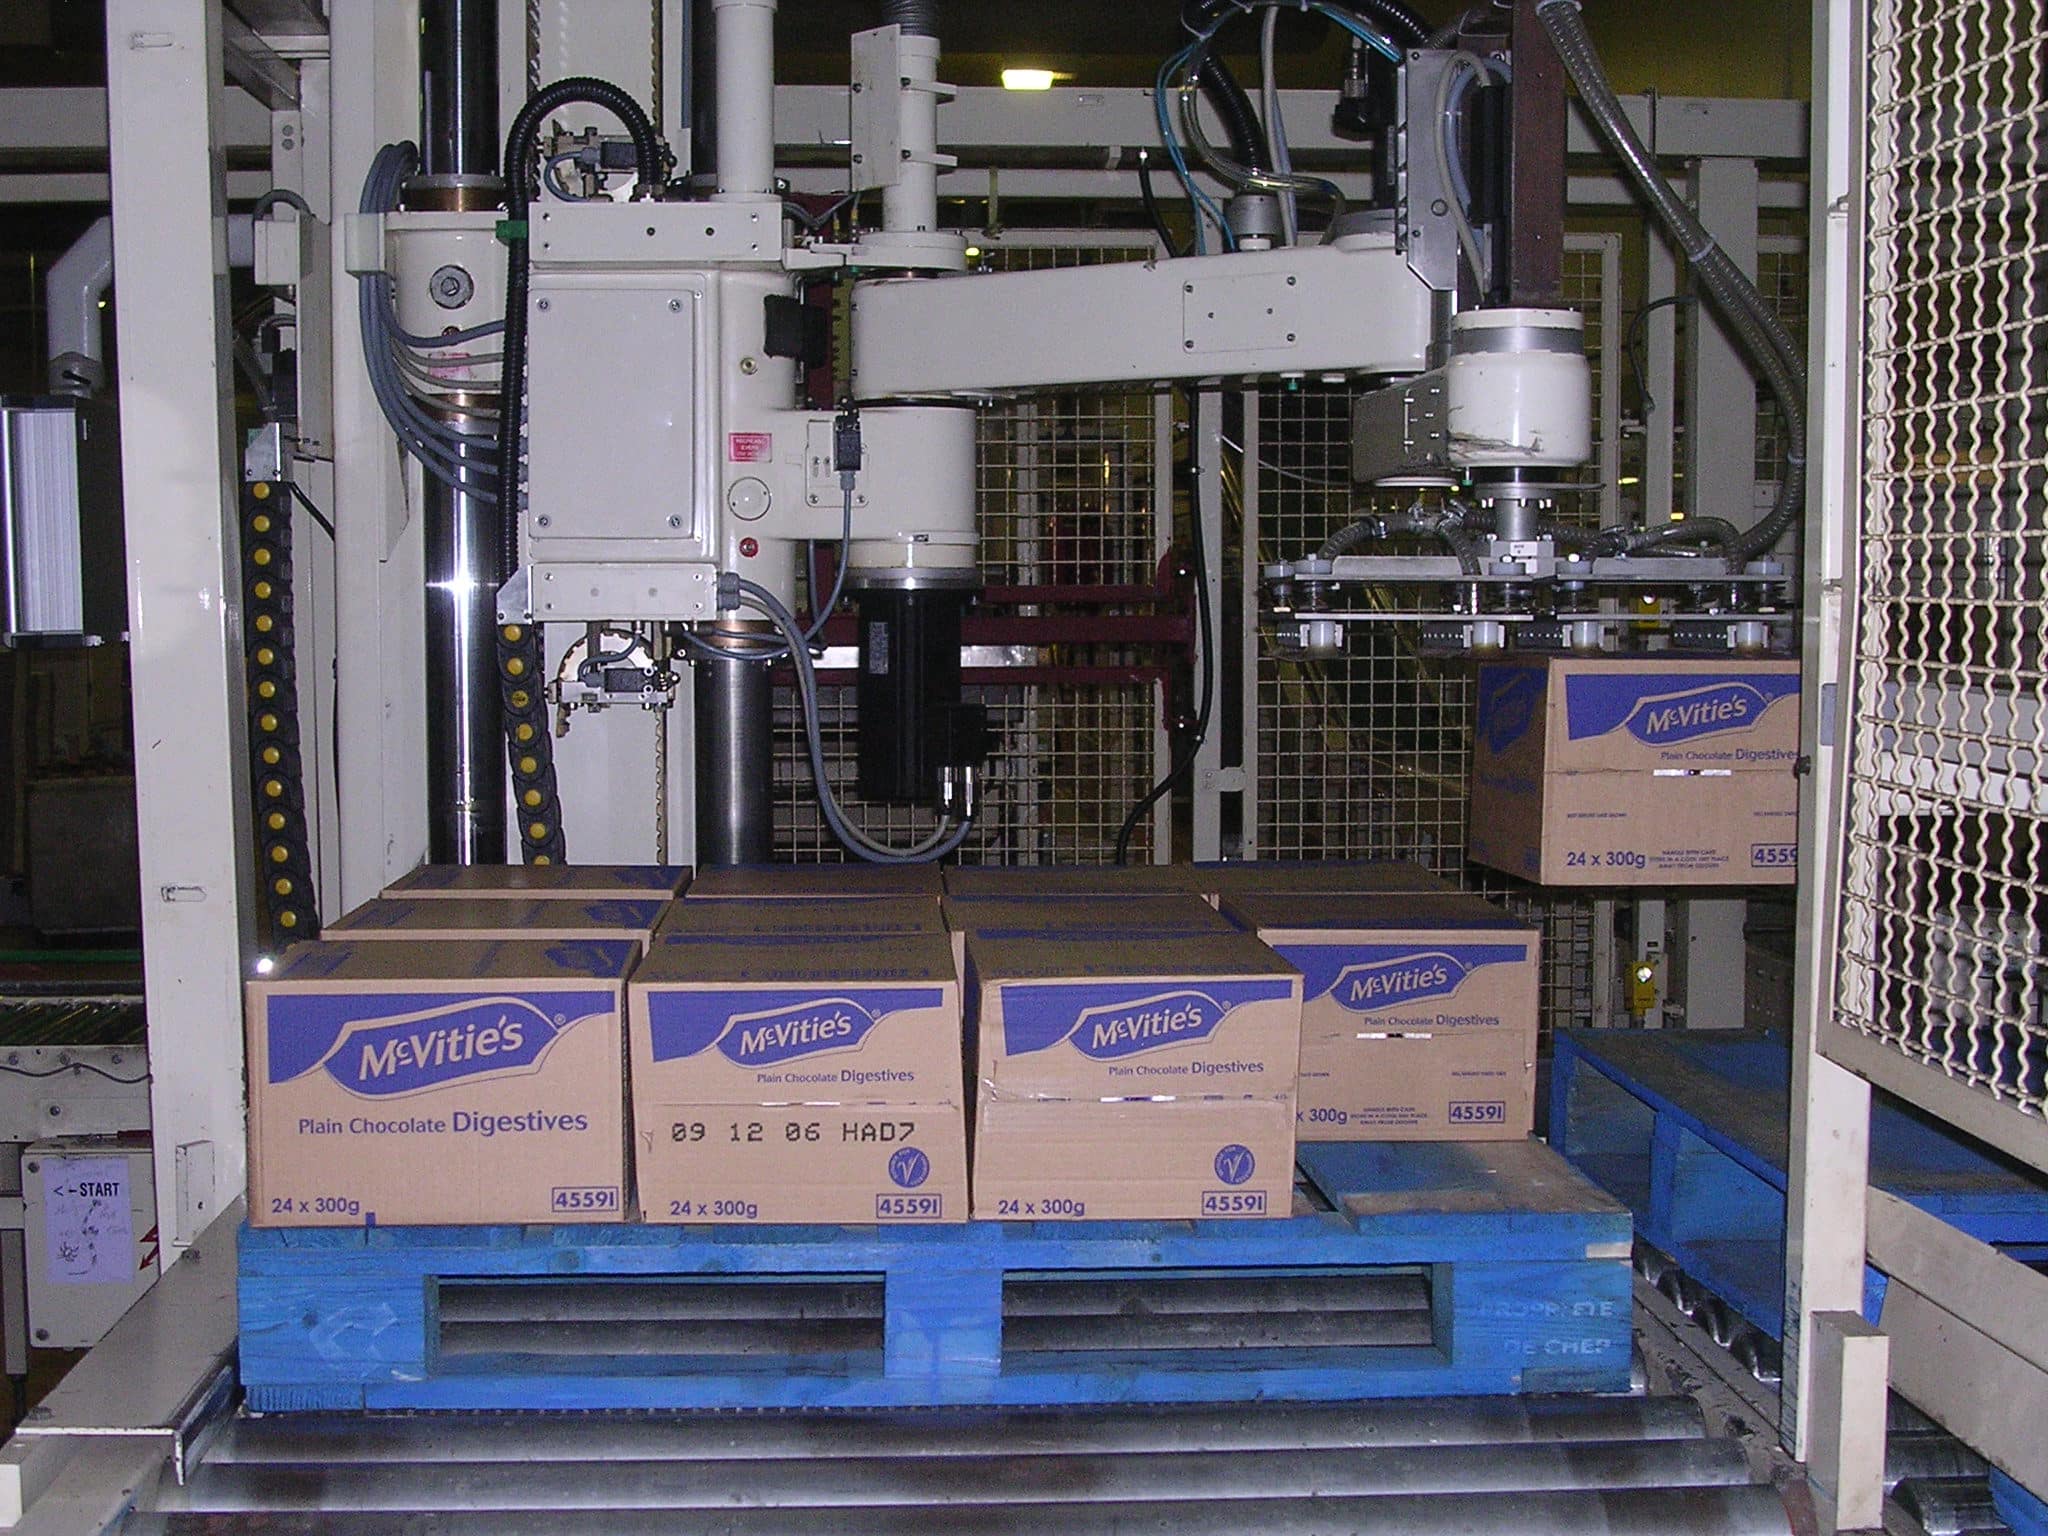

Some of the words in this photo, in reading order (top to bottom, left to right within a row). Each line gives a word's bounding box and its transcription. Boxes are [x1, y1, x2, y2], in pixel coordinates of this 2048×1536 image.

[1646, 696, 1748, 735] McVitie's
[1661, 751, 1683, 760] Plain
[1686, 750, 1733, 760] Chocolate
[1735, 747, 1799, 763] Digestive
[1567, 852, 1585, 866] 24
[1591, 856, 1600, 866] x
[1606, 852, 1646, 868] 300g
[1754, 848, 1798, 863] 4559
[1351, 964, 1447, 1002] McVitie's
[1092, 1003, 1202, 1049] McVitie's
[1364, 1016, 1386, 1026] Plain
[1388, 1016, 1433, 1026] Chocolate
[1436, 1014, 1500, 1028] Digestives
[740, 1011, 852, 1056] McVitie's
[358, 1014, 524, 1081] McVitie's
[757, 1073, 782, 1083] Plain
[785, 1072, 838, 1083] Chocolate
[840, 1068, 915, 1085] Digestives
[1108, 1066, 1133, 1076] Plain
[1136, 1065, 1189, 1076] Chocolate
[1191, 1060, 1264, 1077] Digestives
[299, 1118, 343, 1135] Plain
[350, 1117, 446, 1135] Chocolate
[453, 1110, 588, 1137] Digestives
[1309, 1108, 1348, 1125] 300g
[671, 1122, 706, 1142] 09
[729, 1122, 764, 1142] 12
[785, 1122, 821, 1142] 06
[842, 1122, 916, 1142] HAD7
[79, 1182, 120, 1197] START
[271, 1198, 293, 1214] 24
[299, 1202, 310, 1214] x
[314, 1198, 360, 1216] 300g
[670, 1200, 692, 1216] 24
[696, 1204, 708, 1216] x
[713, 1200, 758, 1219] 300g
[997, 1200, 1019, 1215] 24
[1024, 1204, 1035, 1215] x
[1040, 1199, 1085, 1217] 300g
